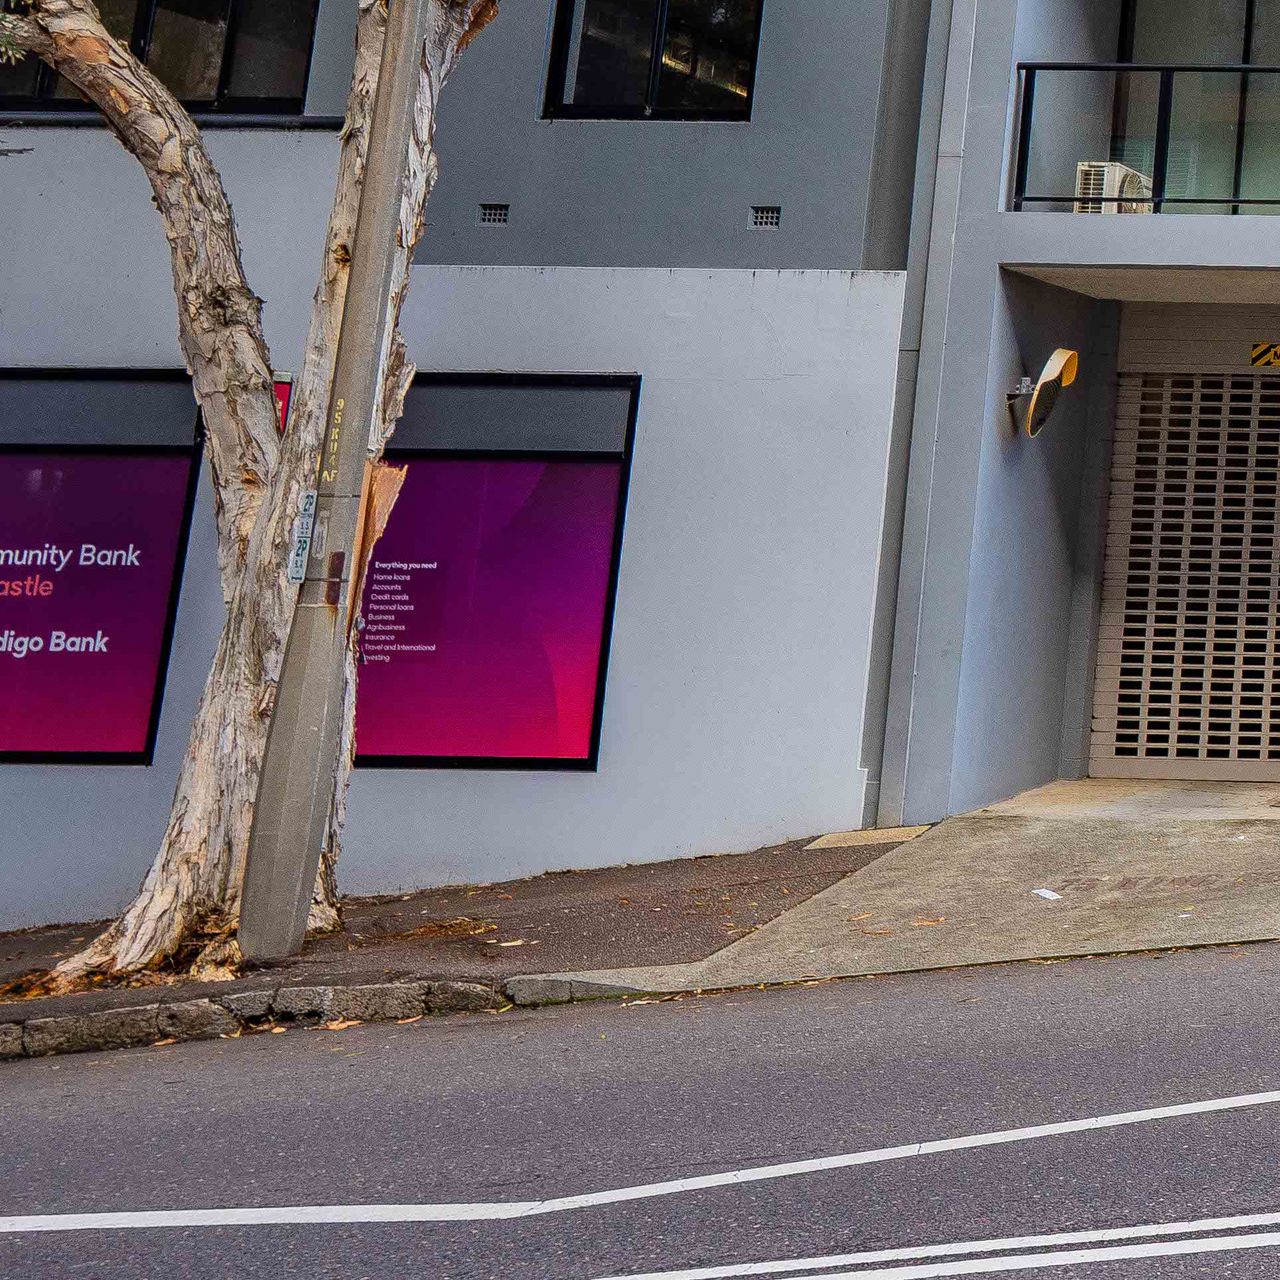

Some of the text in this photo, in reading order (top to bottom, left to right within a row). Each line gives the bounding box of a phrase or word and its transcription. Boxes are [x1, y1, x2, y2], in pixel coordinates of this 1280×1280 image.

[79, 543, 141, 566] Bank
[296, 539, 308, 557] 2P
[375, 561, 408, 570] Everything
[421, 561, 437, 569] need
[369, 603, 397, 611] Personal
[49, 630, 110, 652] Bank
[365, 643, 384, 651] Travel
[397, 643, 436, 651] International
